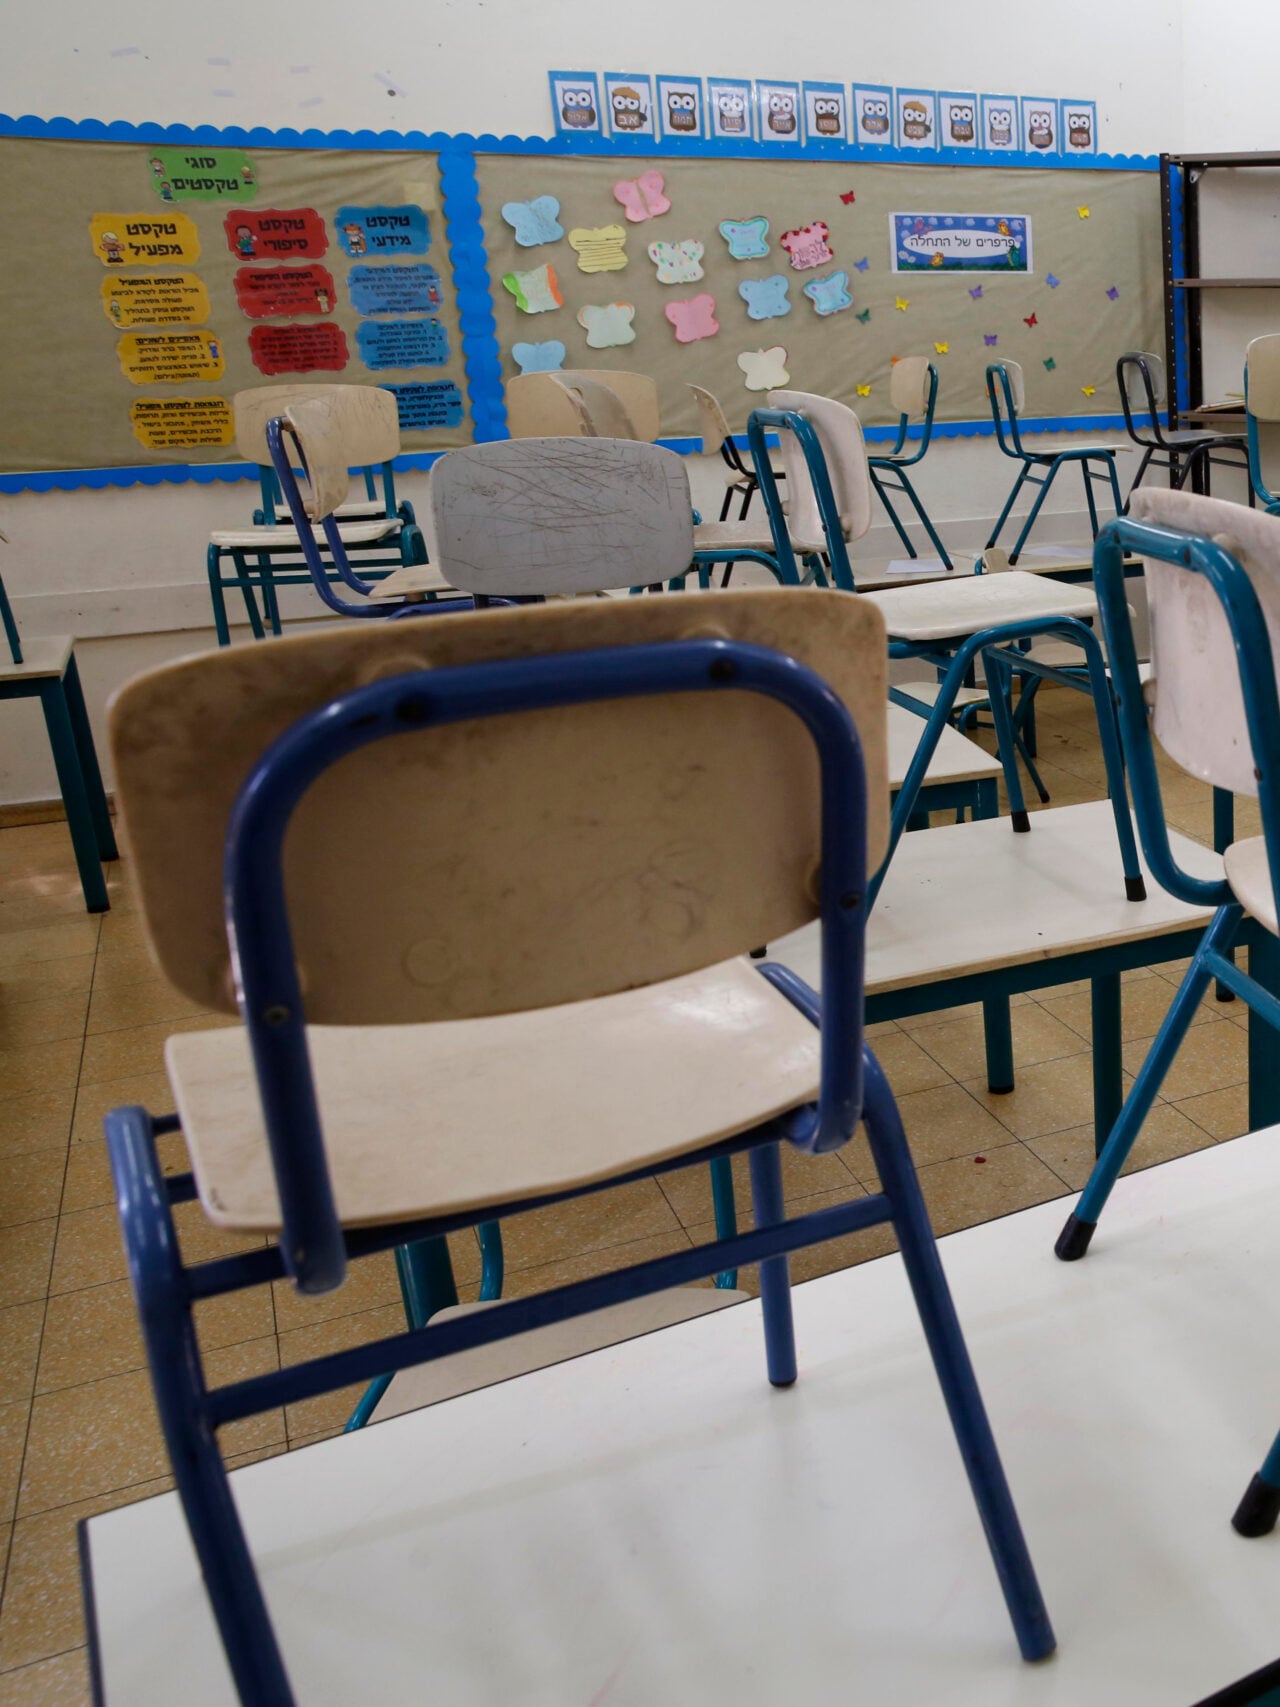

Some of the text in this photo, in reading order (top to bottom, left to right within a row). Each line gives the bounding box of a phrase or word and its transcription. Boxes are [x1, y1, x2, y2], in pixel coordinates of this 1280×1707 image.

[618, 114, 638, 125] אב
[184, 157, 217, 169] סוגי
[170, 178, 239, 194] טקסטים
[258, 219, 305, 234] טקסט
[365, 215, 410, 230] טקסט
[126, 223, 176, 238] טקסט
[263, 238, 308, 251] סיפורי
[371, 235, 411, 247] מידעי
[910, 235, 1015, 248] פרפרים של התחלה
[128, 242, 183, 256] מפעיל
